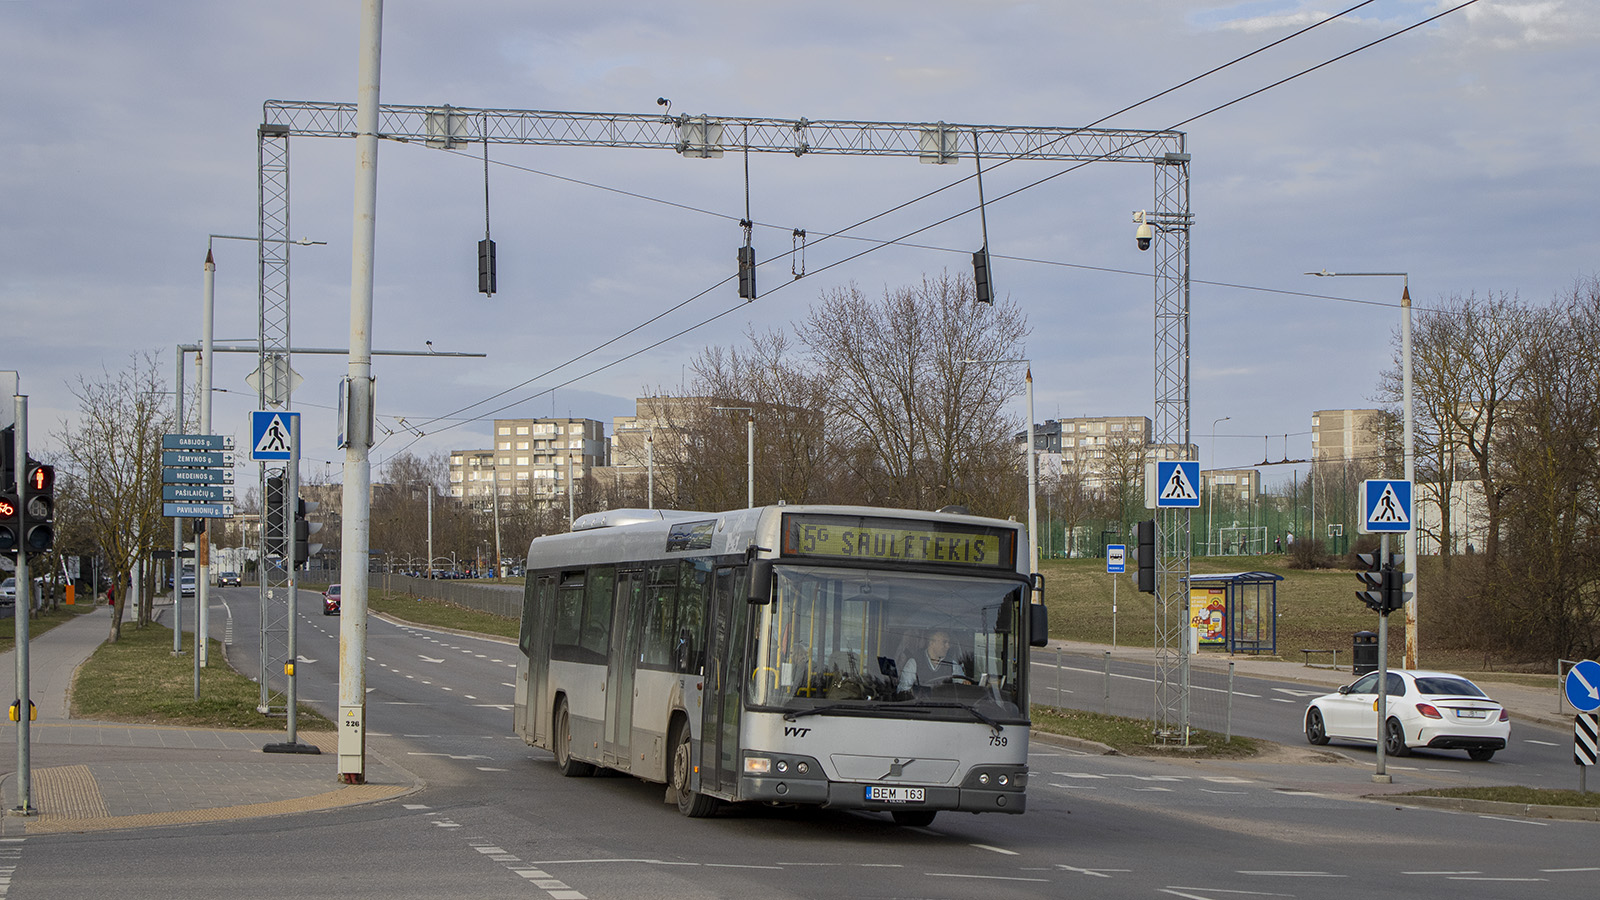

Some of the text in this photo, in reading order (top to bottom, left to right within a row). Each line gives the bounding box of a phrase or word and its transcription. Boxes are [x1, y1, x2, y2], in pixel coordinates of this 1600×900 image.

[179, 438, 205, 446] GABIJOS
[177, 455, 207, 463] ŽEMYNOS
[175, 489, 209, 498] PAŠILAIČIŲ
[176, 506, 214, 515] PAVILNIONIŲ
[214, 508, 221, 516] g.
[842, 531, 985, 563] SAULĖTEKIS
[784, 726, 812, 738] VVT
[989, 736, 1008, 747] 759
[872, 788, 897, 799] BEM
[904, 789, 923, 800] 163
